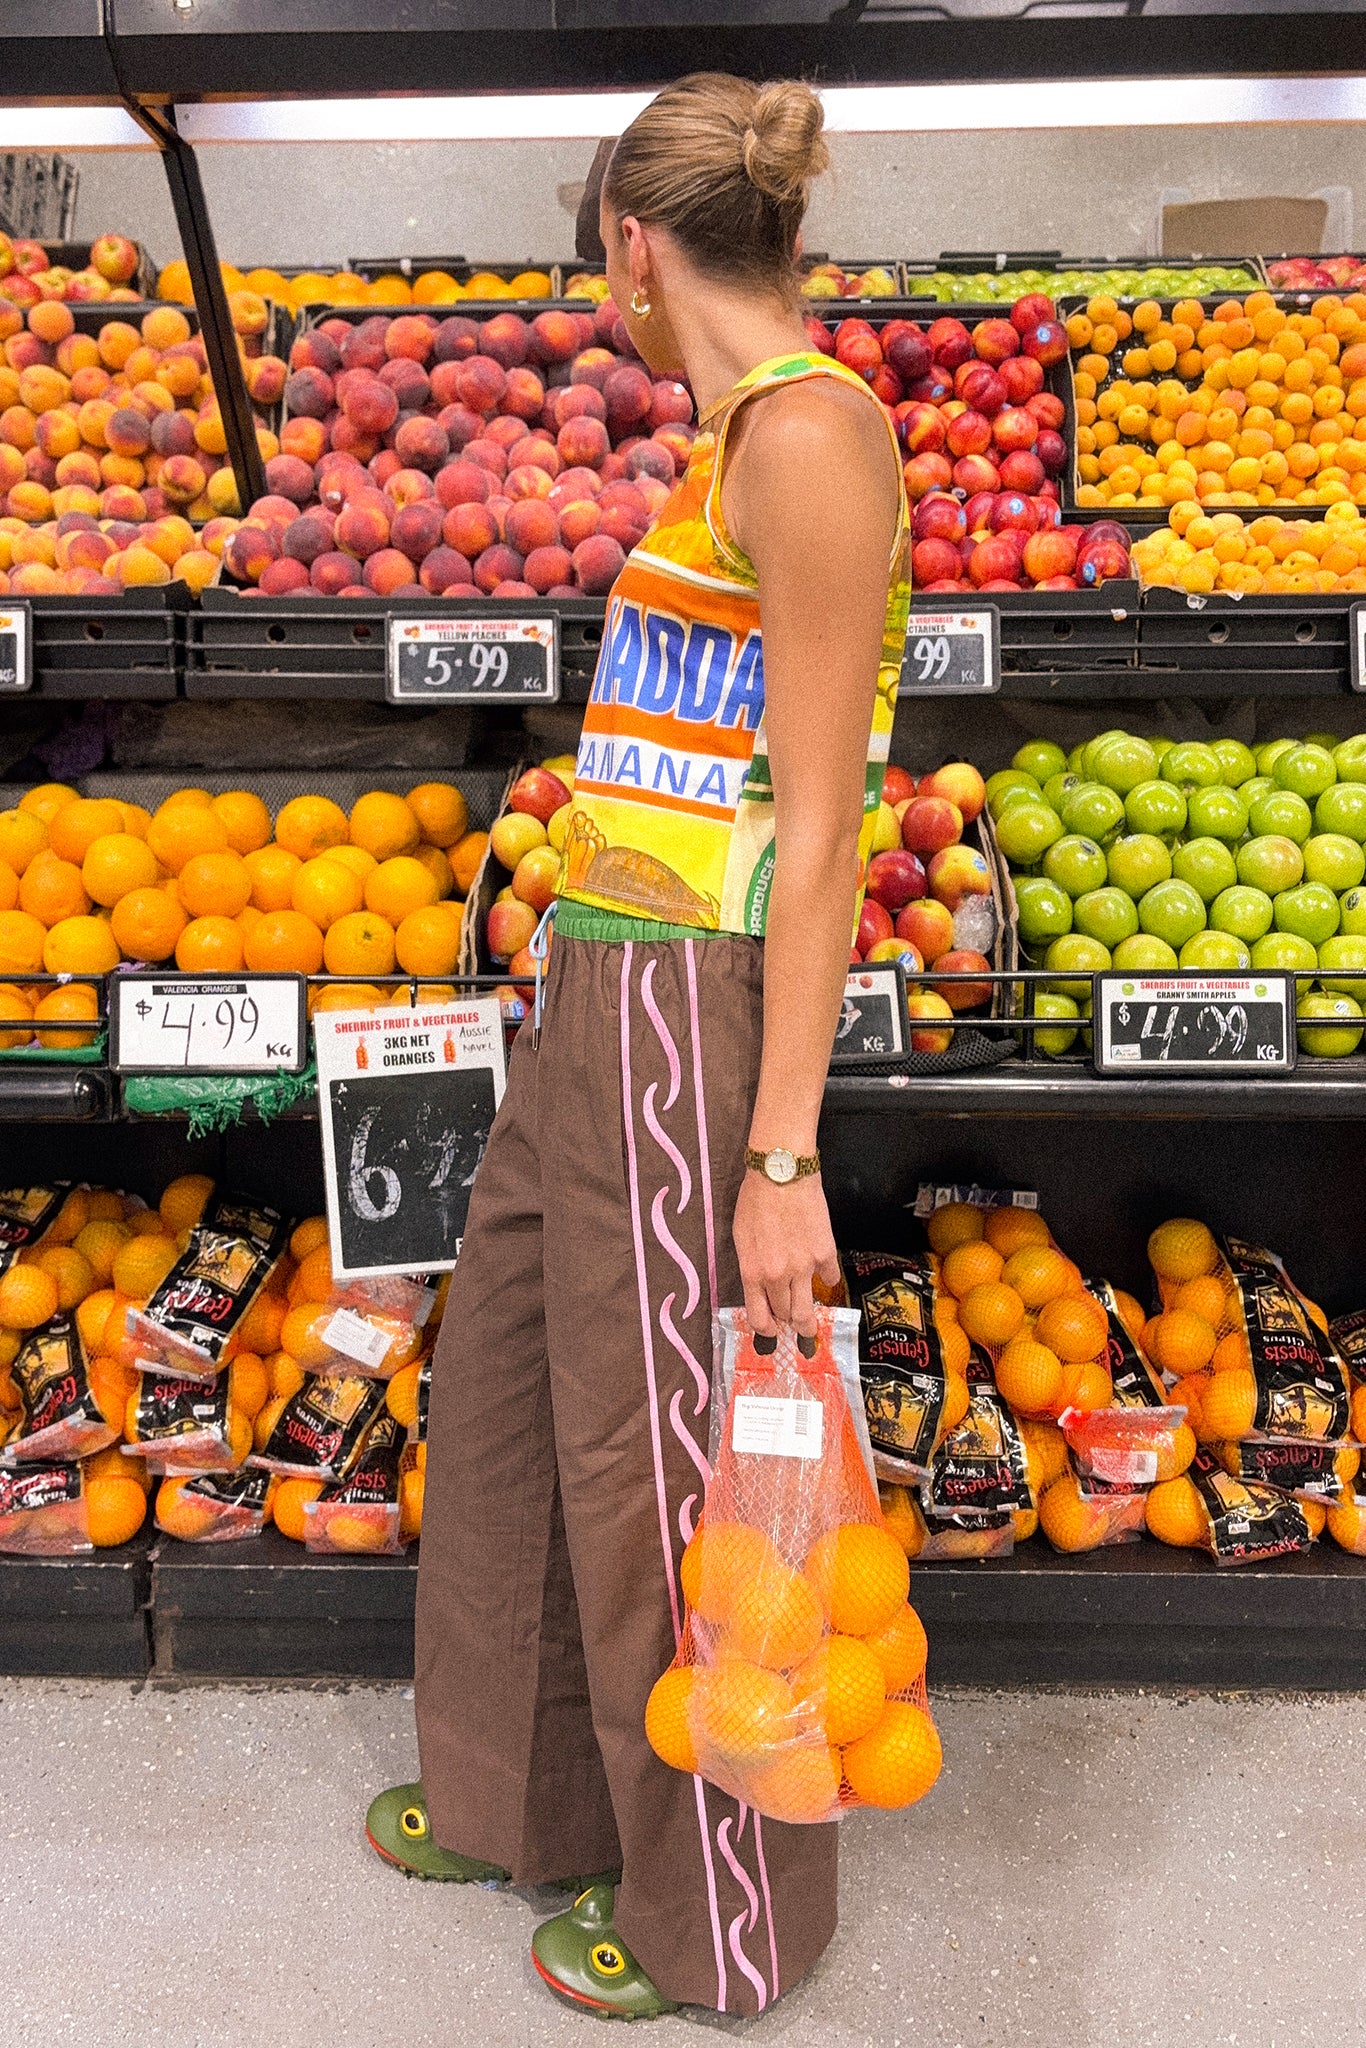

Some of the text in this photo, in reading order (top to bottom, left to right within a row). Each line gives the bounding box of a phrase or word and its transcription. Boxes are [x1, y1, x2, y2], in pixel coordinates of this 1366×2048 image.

[438, 632, 507, 641] YELLOW PEACHES
[907, 625, 946, 634] CTARINES
[591, 598, 765, 731] ADDA
[523, 677, 542, 690] KG
[577, 741, 750, 804] ANANA
[163, 986, 238, 994] VALENCIA ORANGES
[1140, 981, 1250, 990] SHERRIFS FRUIT & VEGETABLES
[1156, 991, 1237, 1000] GRANNY SMITH APPLES
[335, 1012, 480, 1034] SHERRIFS FRUIT & VEGETABLES
[459, 1025, 492, 1039] AUSSIE
[384, 1034, 431, 1049] 3KG NET
[463, 1041, 496, 1052] NAVEL
[863, 1036, 885, 1052] KG
[266, 1043, 293, 1058] KG
[1256, 1044, 1280, 1061] KG
[383, 1051, 436, 1067] ORANGES
[868, 1330, 908, 1343] Citrus
[1263, 1335, 1305, 1347] Citrus
[869, 1339, 930, 1368] Genesis
[1264, 1345, 1326, 1373] Genesis
[295, 1407, 323, 1433] Citrus
[945, 1467, 1013, 1503] Genesis
